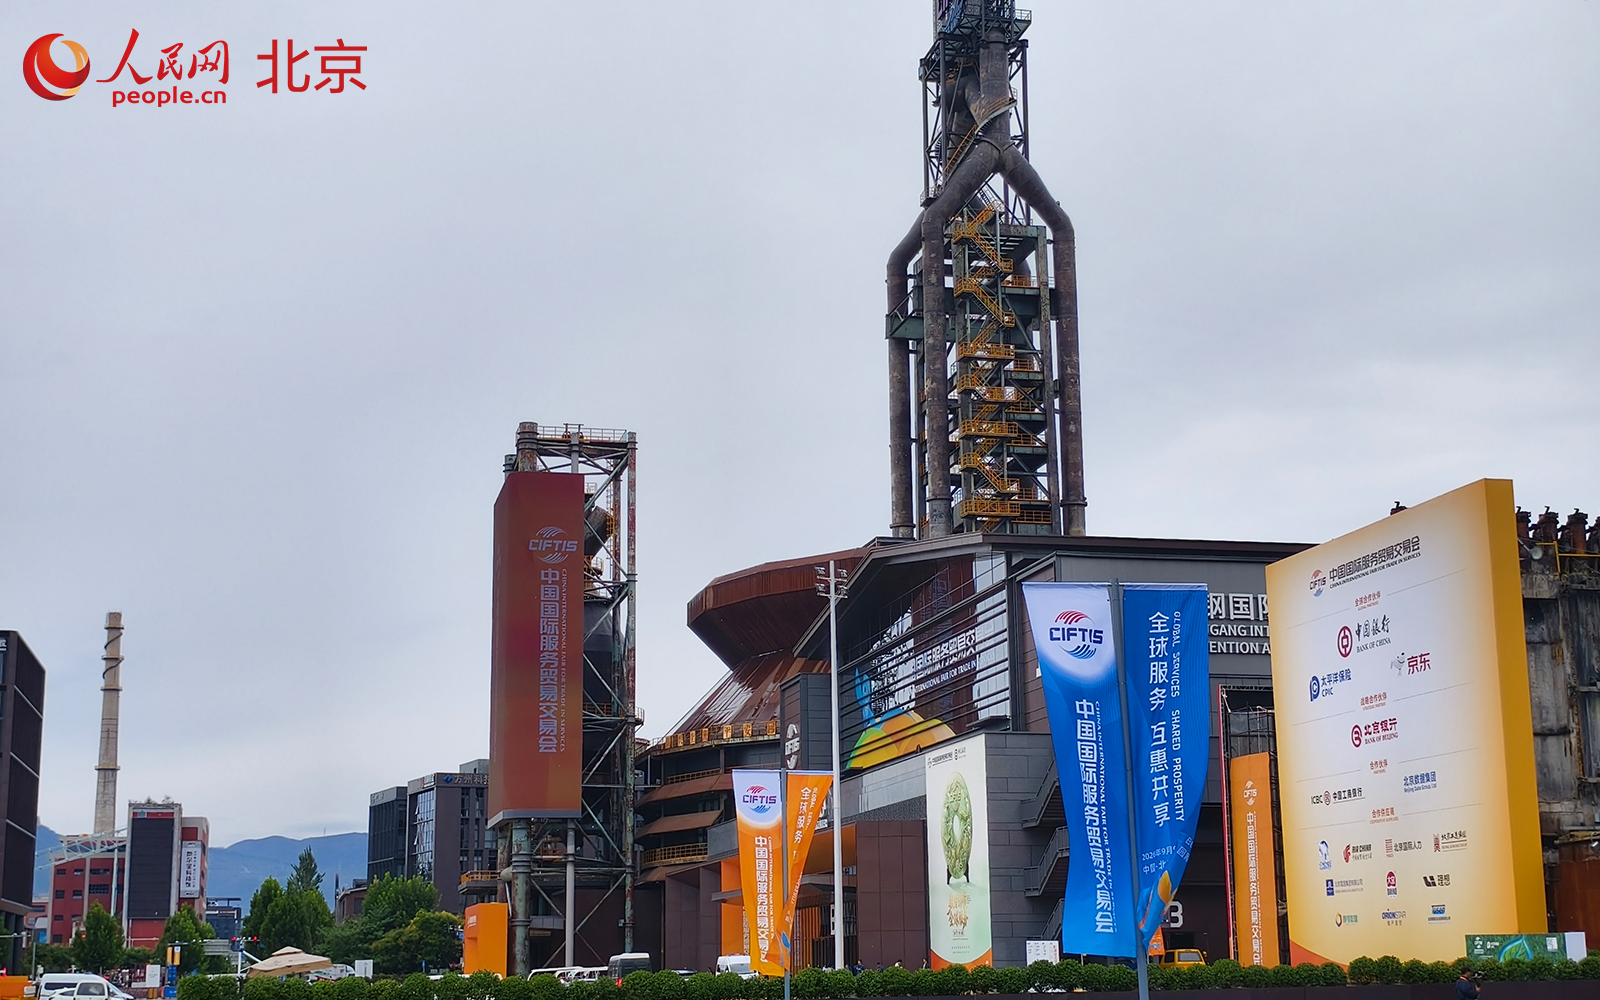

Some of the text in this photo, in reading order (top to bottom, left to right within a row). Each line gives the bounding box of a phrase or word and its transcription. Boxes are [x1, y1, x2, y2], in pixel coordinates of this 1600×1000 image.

[528, 539, 578, 552] CIFTIS
[1329, 535, 1421, 581] 中国国际服务贸易交易会
[1050, 627, 1103, 644] CIFTIS
[1208, 624, 1247, 637] GANG
[1355, 614, 1390, 641] 中国银行
[1208, 641, 1260, 654] ENTION
[1356, 645, 1370, 653] BANK
[1376, 637, 1392, 647] CHINA
[539, 568, 560, 753] 中国国际服务贸易交易会
[1407, 652, 1431, 675] 京东
[1321, 668, 1352, 687] 太平洋保险
[1322, 687, 1334, 697] CPIC
[1148, 611, 1170, 827] 全球服务 互惠共享
[1170, 611, 1185, 821] GLOBAL SERVICES SHARED PROSPERITY
[1364, 718, 1398, 736] 北京银行
[1382, 732, 1398, 741] BEIJING
[1404, 771, 1436, 786] 北京数据集团
[742, 794, 777, 804] CIFTIS
[1311, 794, 1323, 804] ICBC
[1332, 787, 1362, 801] 中国工商银行
[794, 786, 812, 844] 全球服务
[1075, 698, 1114, 933] 中国国际服务贸易交易会
